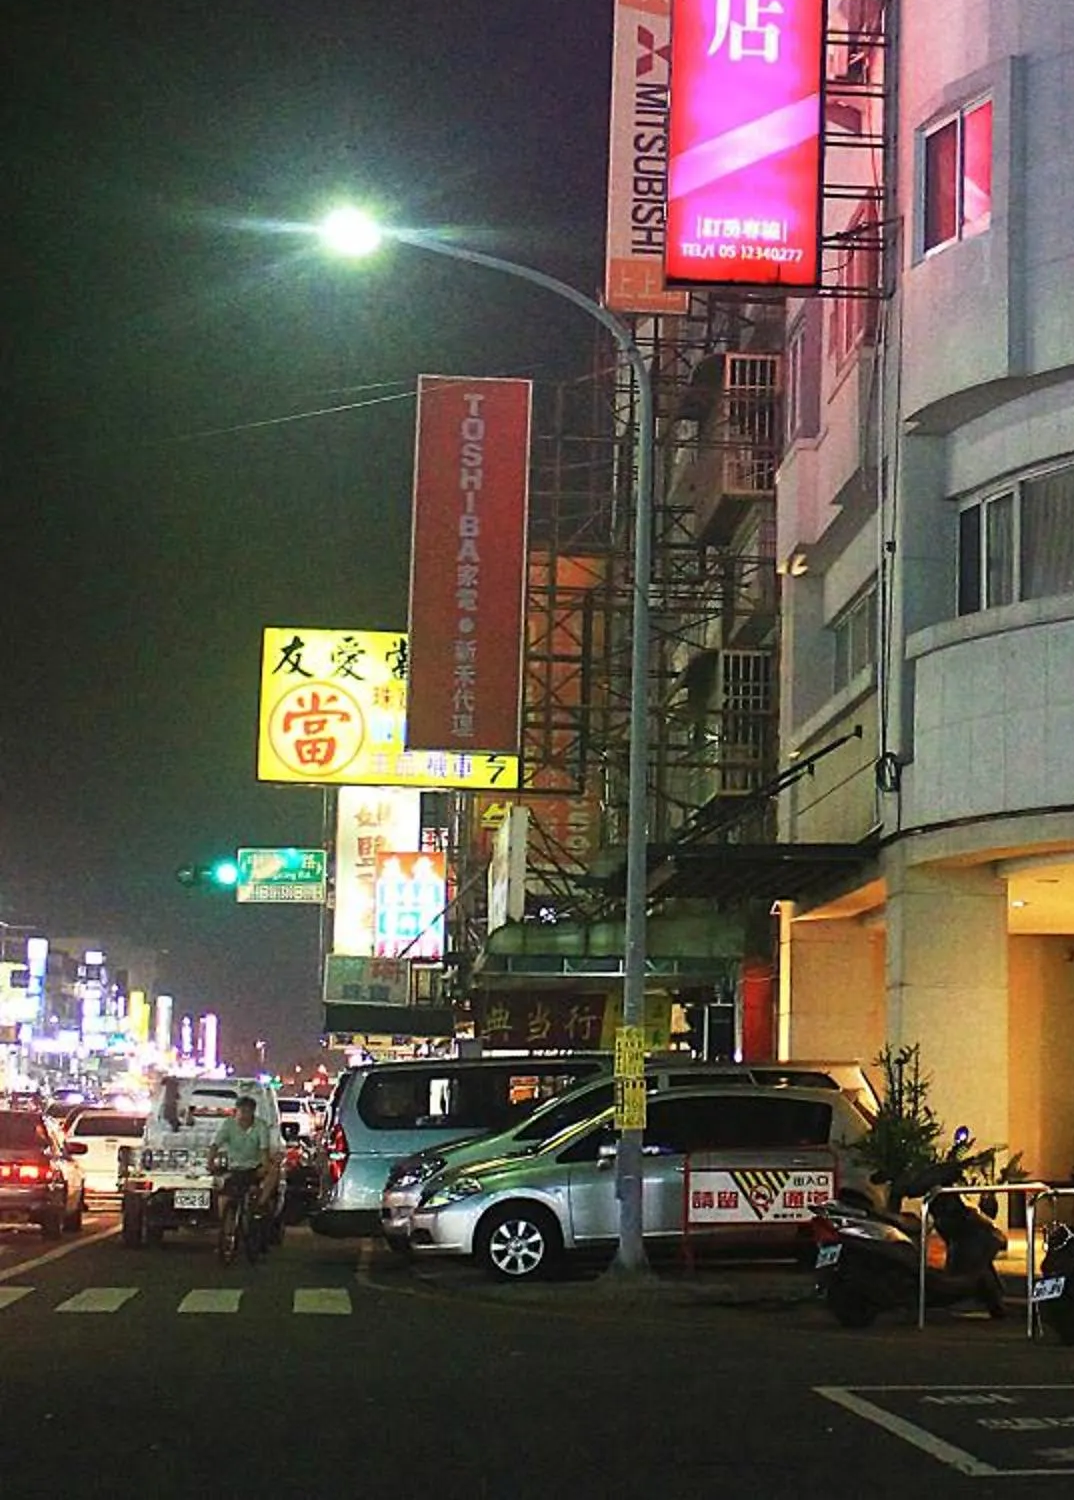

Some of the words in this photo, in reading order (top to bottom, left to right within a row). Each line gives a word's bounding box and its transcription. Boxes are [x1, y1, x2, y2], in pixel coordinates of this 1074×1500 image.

[631, 83, 669, 255] MITSUBISHI
[282, 691, 351, 767] 當
[793, 1175, 829, 1187] 出入口
